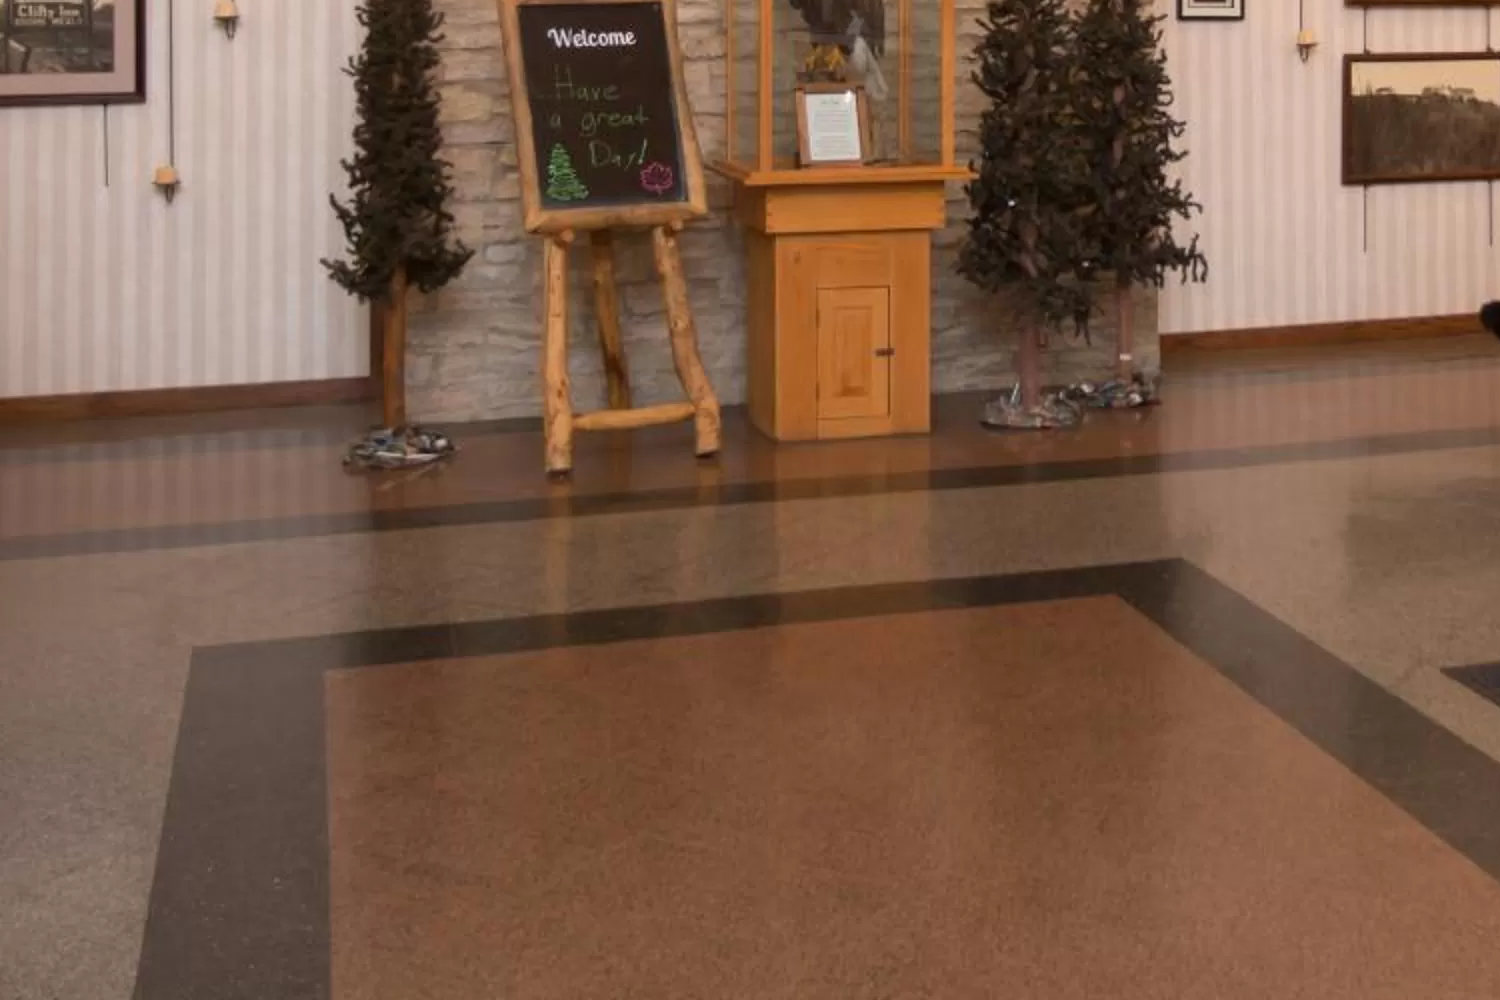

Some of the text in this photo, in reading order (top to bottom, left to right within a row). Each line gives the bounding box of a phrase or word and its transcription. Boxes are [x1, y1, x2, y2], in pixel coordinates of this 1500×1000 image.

[547, 28, 637, 48] Welcome
[554, 64, 620, 101] Have
[550, 104, 649, 137] a great
[589, 138, 648, 170] Day!
